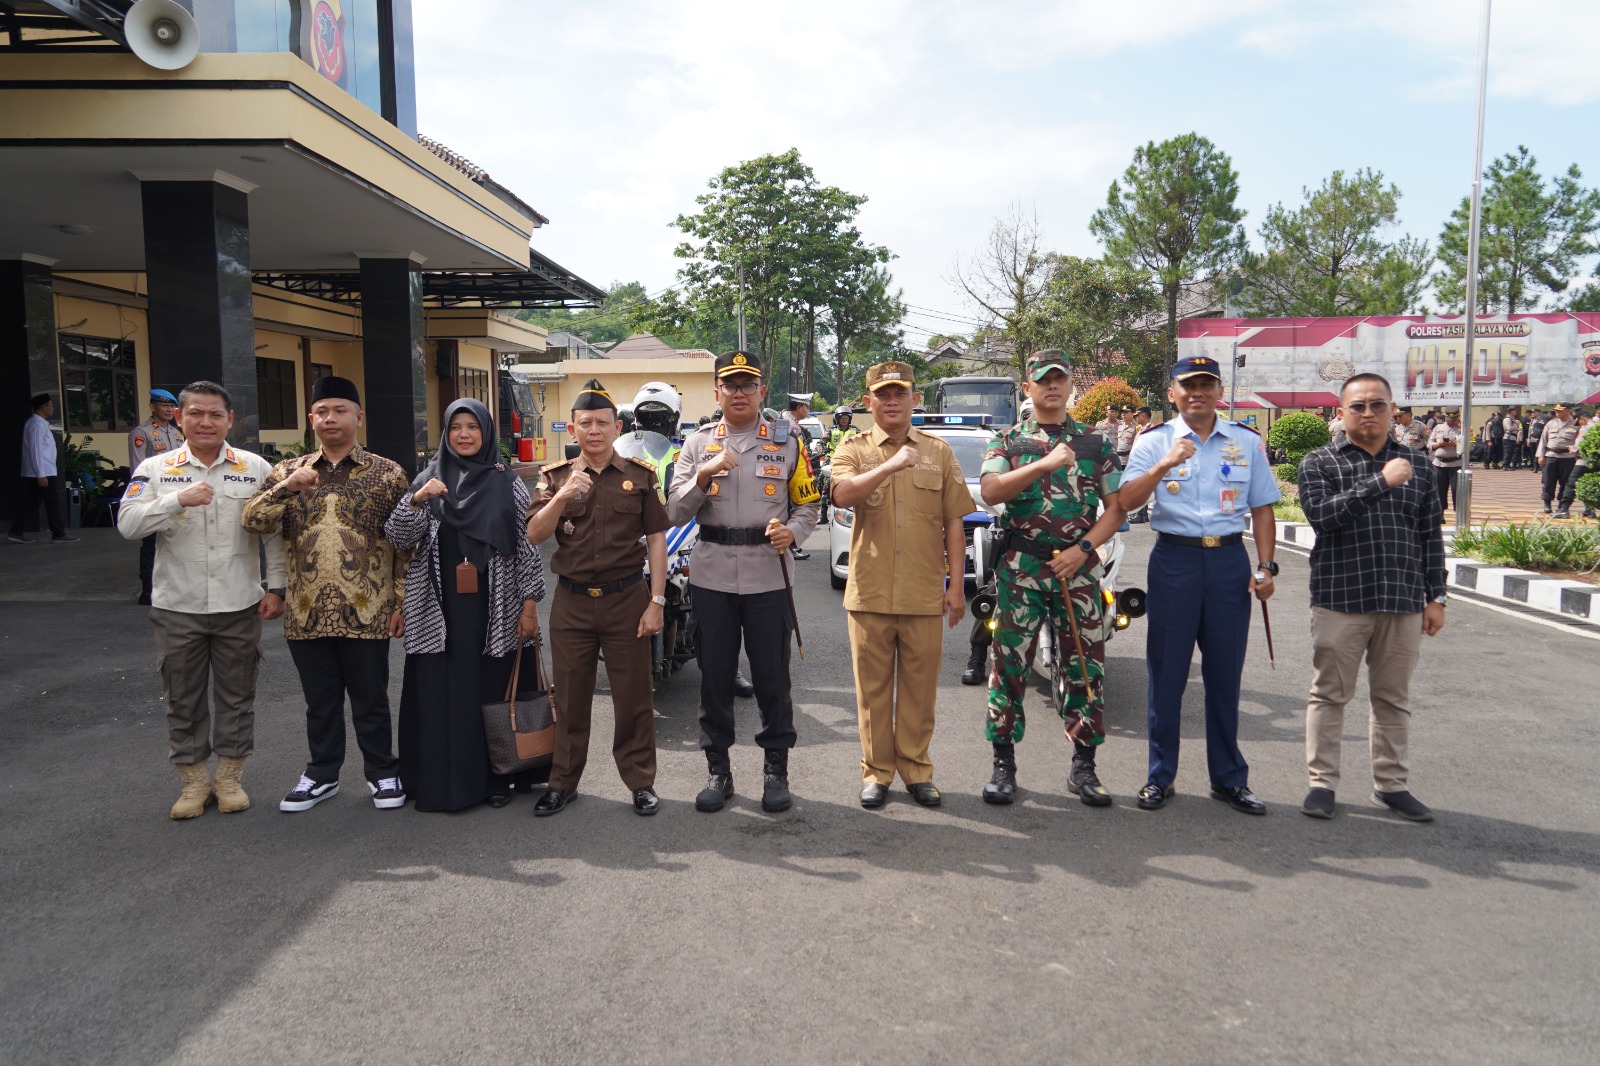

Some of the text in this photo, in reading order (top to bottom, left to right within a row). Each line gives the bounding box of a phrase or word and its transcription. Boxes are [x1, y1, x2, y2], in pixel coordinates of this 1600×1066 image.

[1410, 325, 1524, 336] POLRES TASIKALAYA KOTA
[1407, 342, 1529, 389] HADE
[757, 454, 785, 462] POLRI
